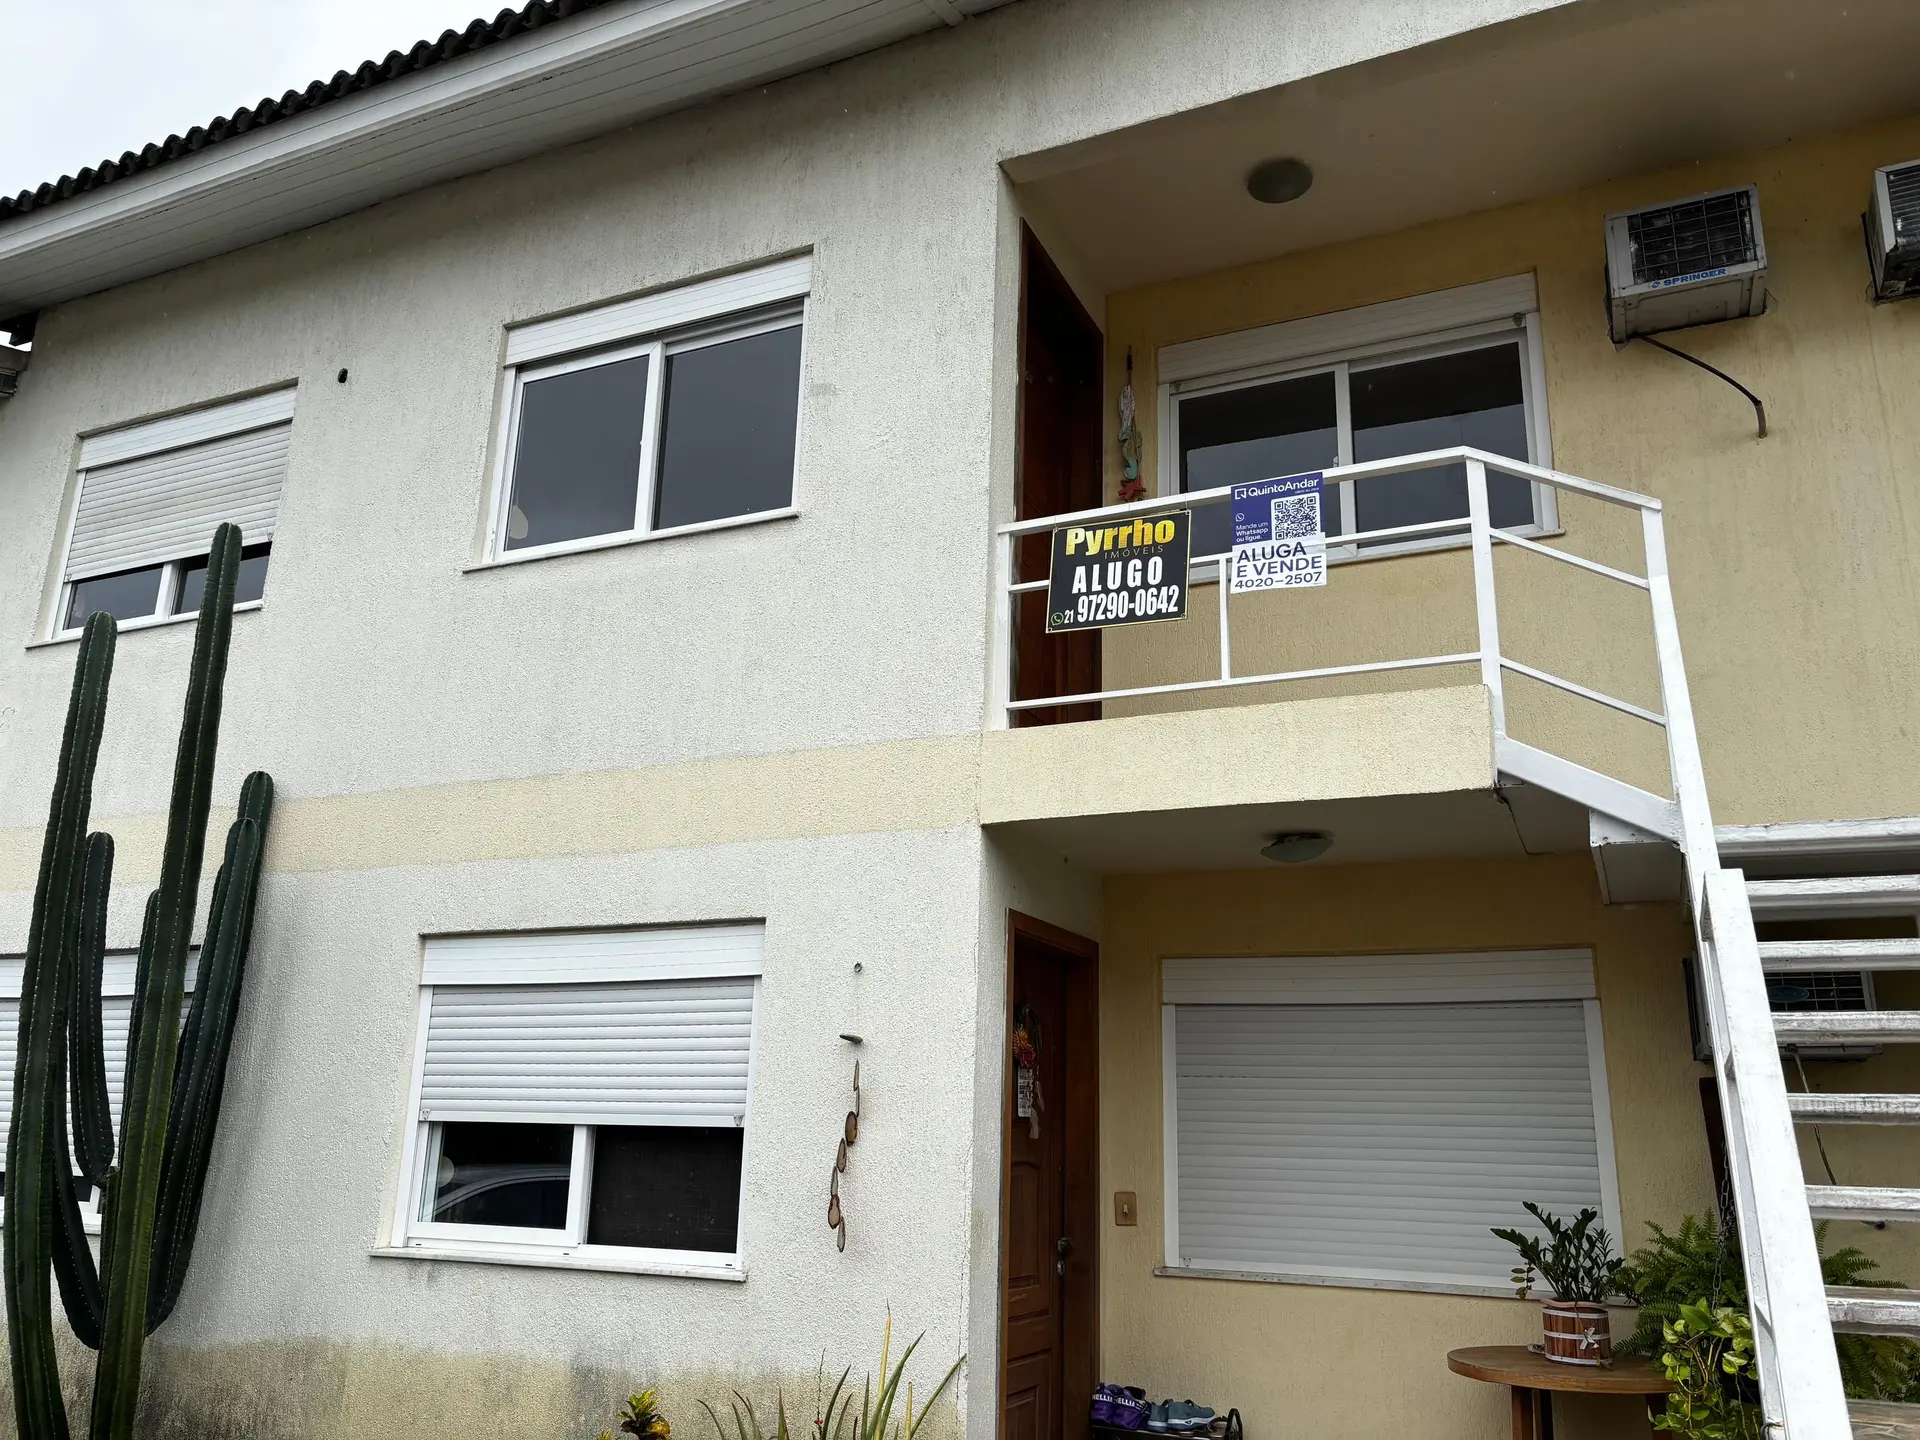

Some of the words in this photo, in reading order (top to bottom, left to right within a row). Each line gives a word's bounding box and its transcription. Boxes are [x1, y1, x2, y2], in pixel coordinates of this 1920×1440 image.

[1664, 268, 1726, 286] SPRINGER
[1248, 478, 1319, 497] QuintoAndar
[1236, 522, 1257, 531] Mande
[1065, 519, 1175, 556] Pyrrho
[1246, 534, 1262, 542] ligue.
[1237, 541, 1307, 564] ALUGA
[1072, 556, 1163, 594] ALUGO
[1236, 564, 1248, 578] E
[1253, 555, 1323, 576] VENDE
[1235, 571, 1322, 589] 4020-2507
[1064, 609, 1075, 624] 21
[1077, 585, 1180, 623] 97290-0642
